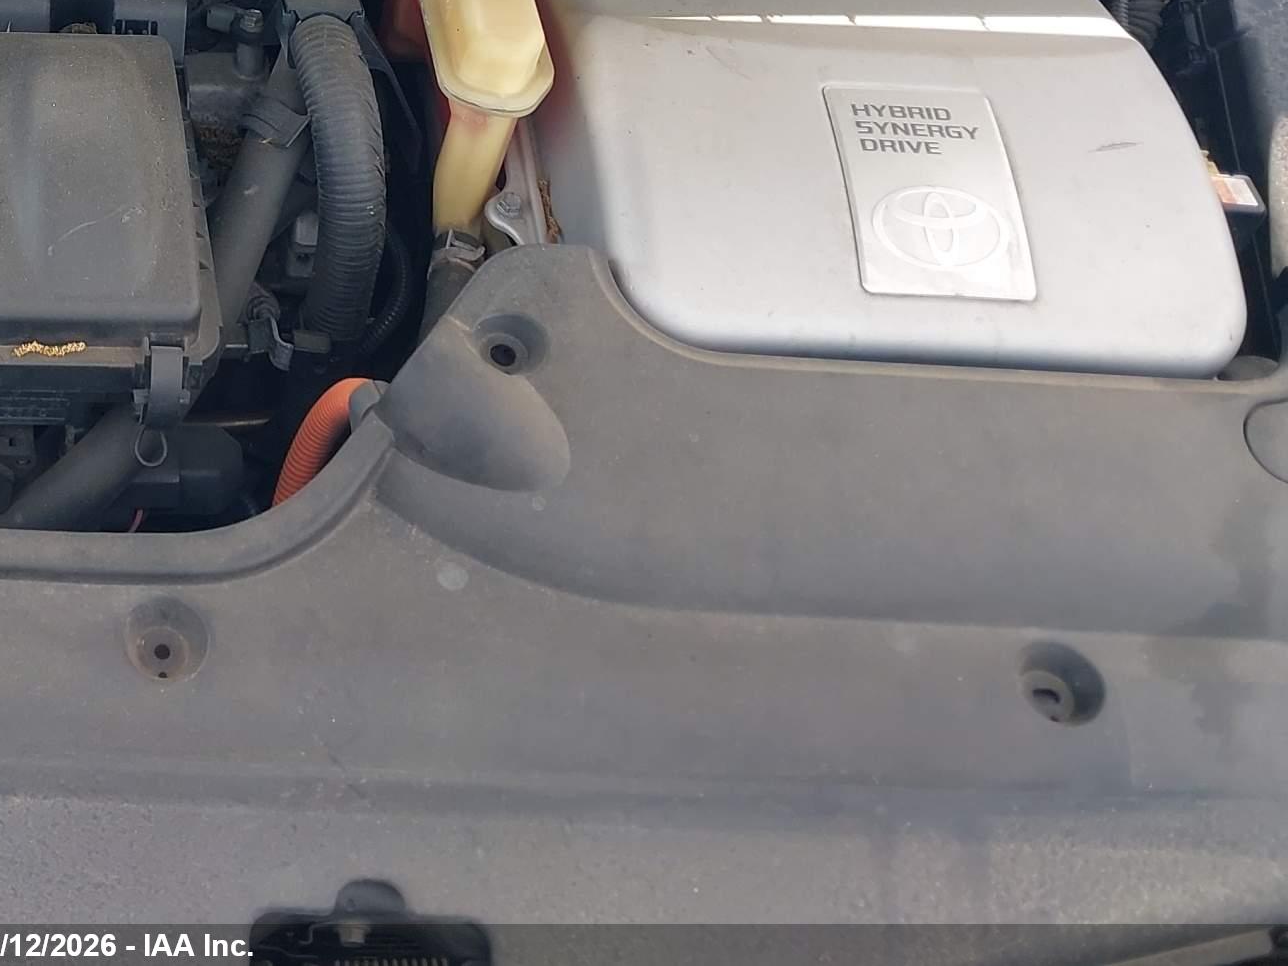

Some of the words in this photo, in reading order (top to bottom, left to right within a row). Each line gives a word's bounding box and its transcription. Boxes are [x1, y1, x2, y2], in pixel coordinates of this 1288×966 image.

[851, 103, 951, 121] HYBRID
[856, 121, 979, 140] SYNERGY
[860, 138, 942, 155] DRIVE
